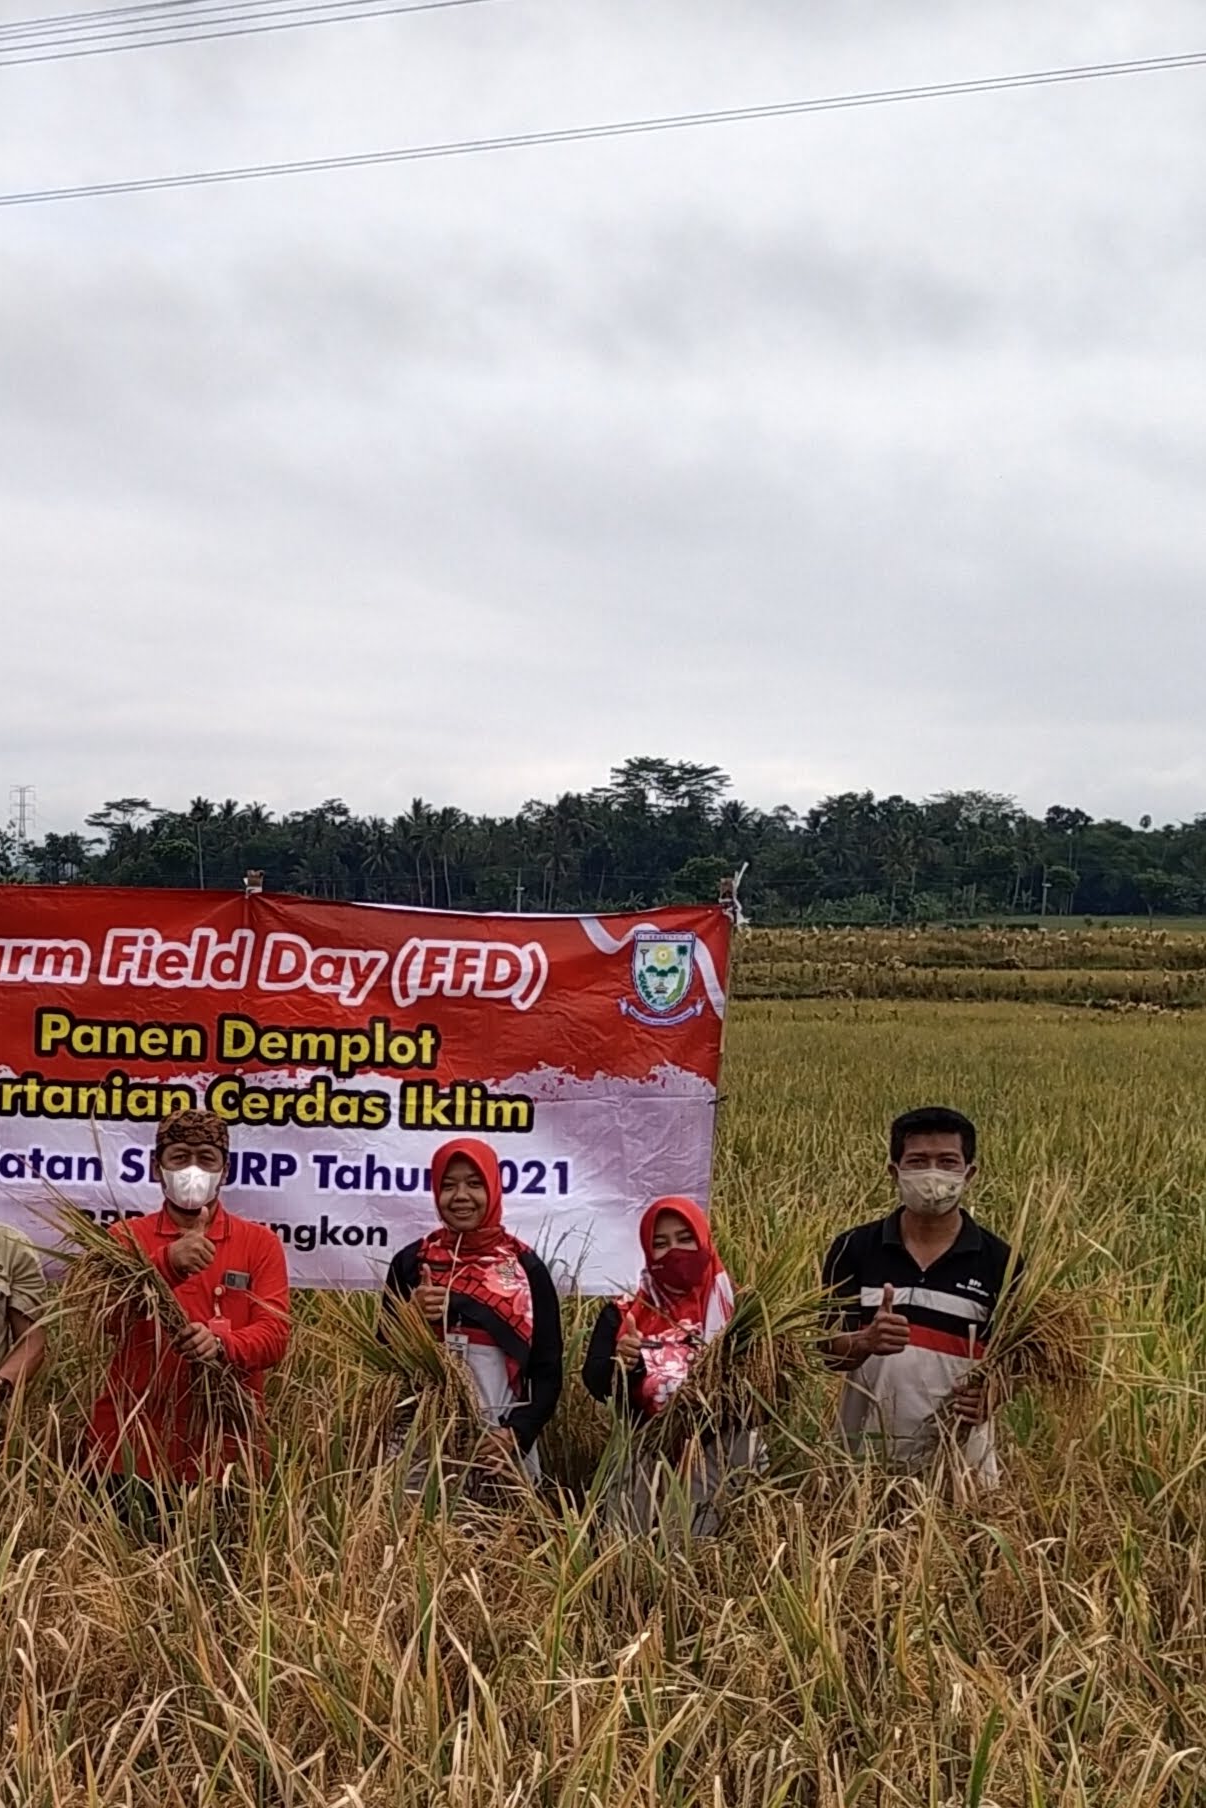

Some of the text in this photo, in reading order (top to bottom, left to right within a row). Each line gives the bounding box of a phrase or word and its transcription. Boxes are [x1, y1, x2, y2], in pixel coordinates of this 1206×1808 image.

[98, 928, 254, 989] Field
[258, 933, 389, 1006] Day
[392, 937, 548, 1010] (FFD)
[39, 1011, 436, 1073] Panen Demplot
[210, 1080, 387, 1125] Cerdas
[403, 1084, 529, 1128] Iklim
[498, 1159, 569, 1196] 021
